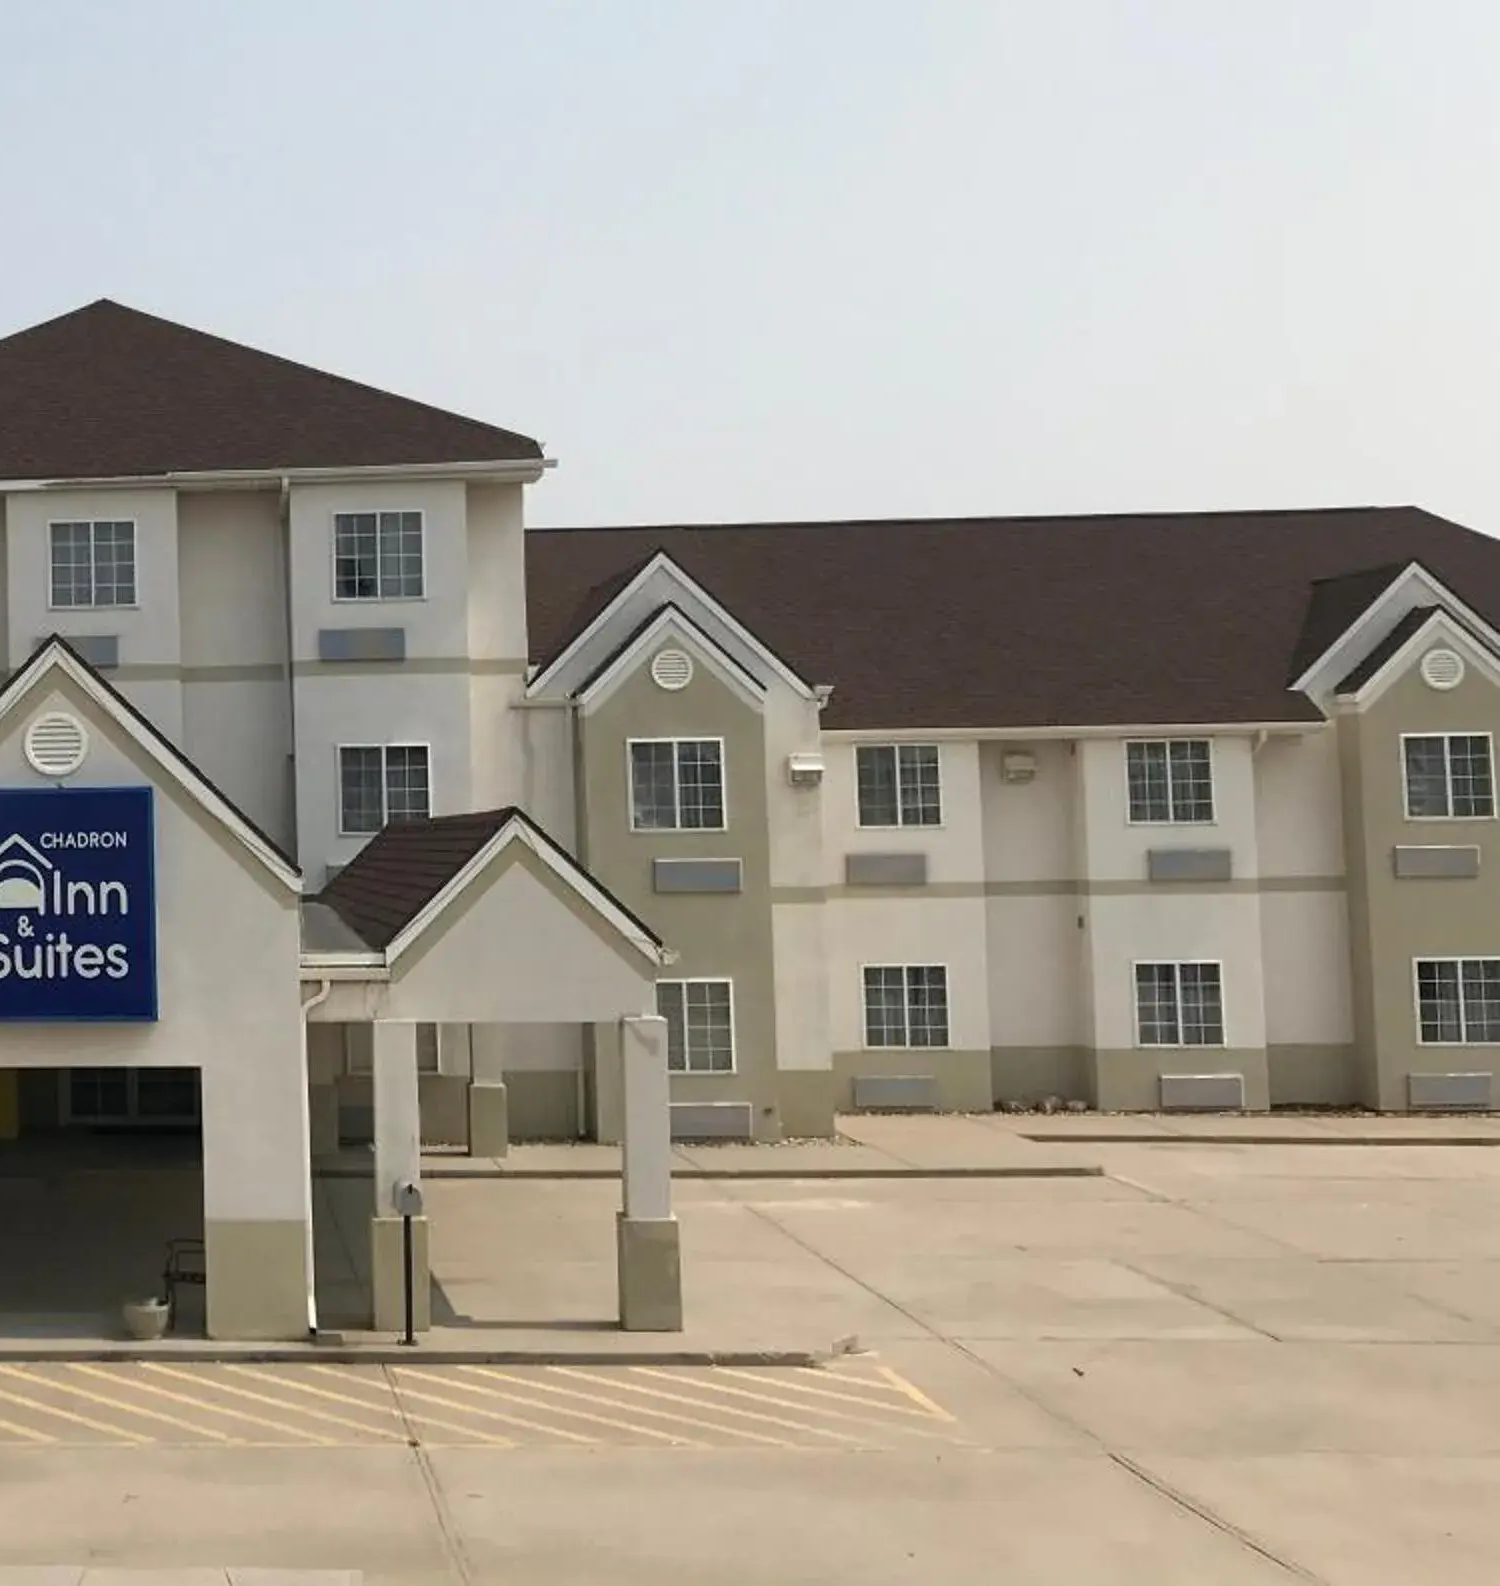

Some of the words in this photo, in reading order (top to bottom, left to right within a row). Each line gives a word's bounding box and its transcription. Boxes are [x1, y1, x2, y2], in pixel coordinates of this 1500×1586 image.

[40, 831, 128, 849] CHADRON
[53, 870, 129, 916] Inn
[17, 915, 35, 937] &
